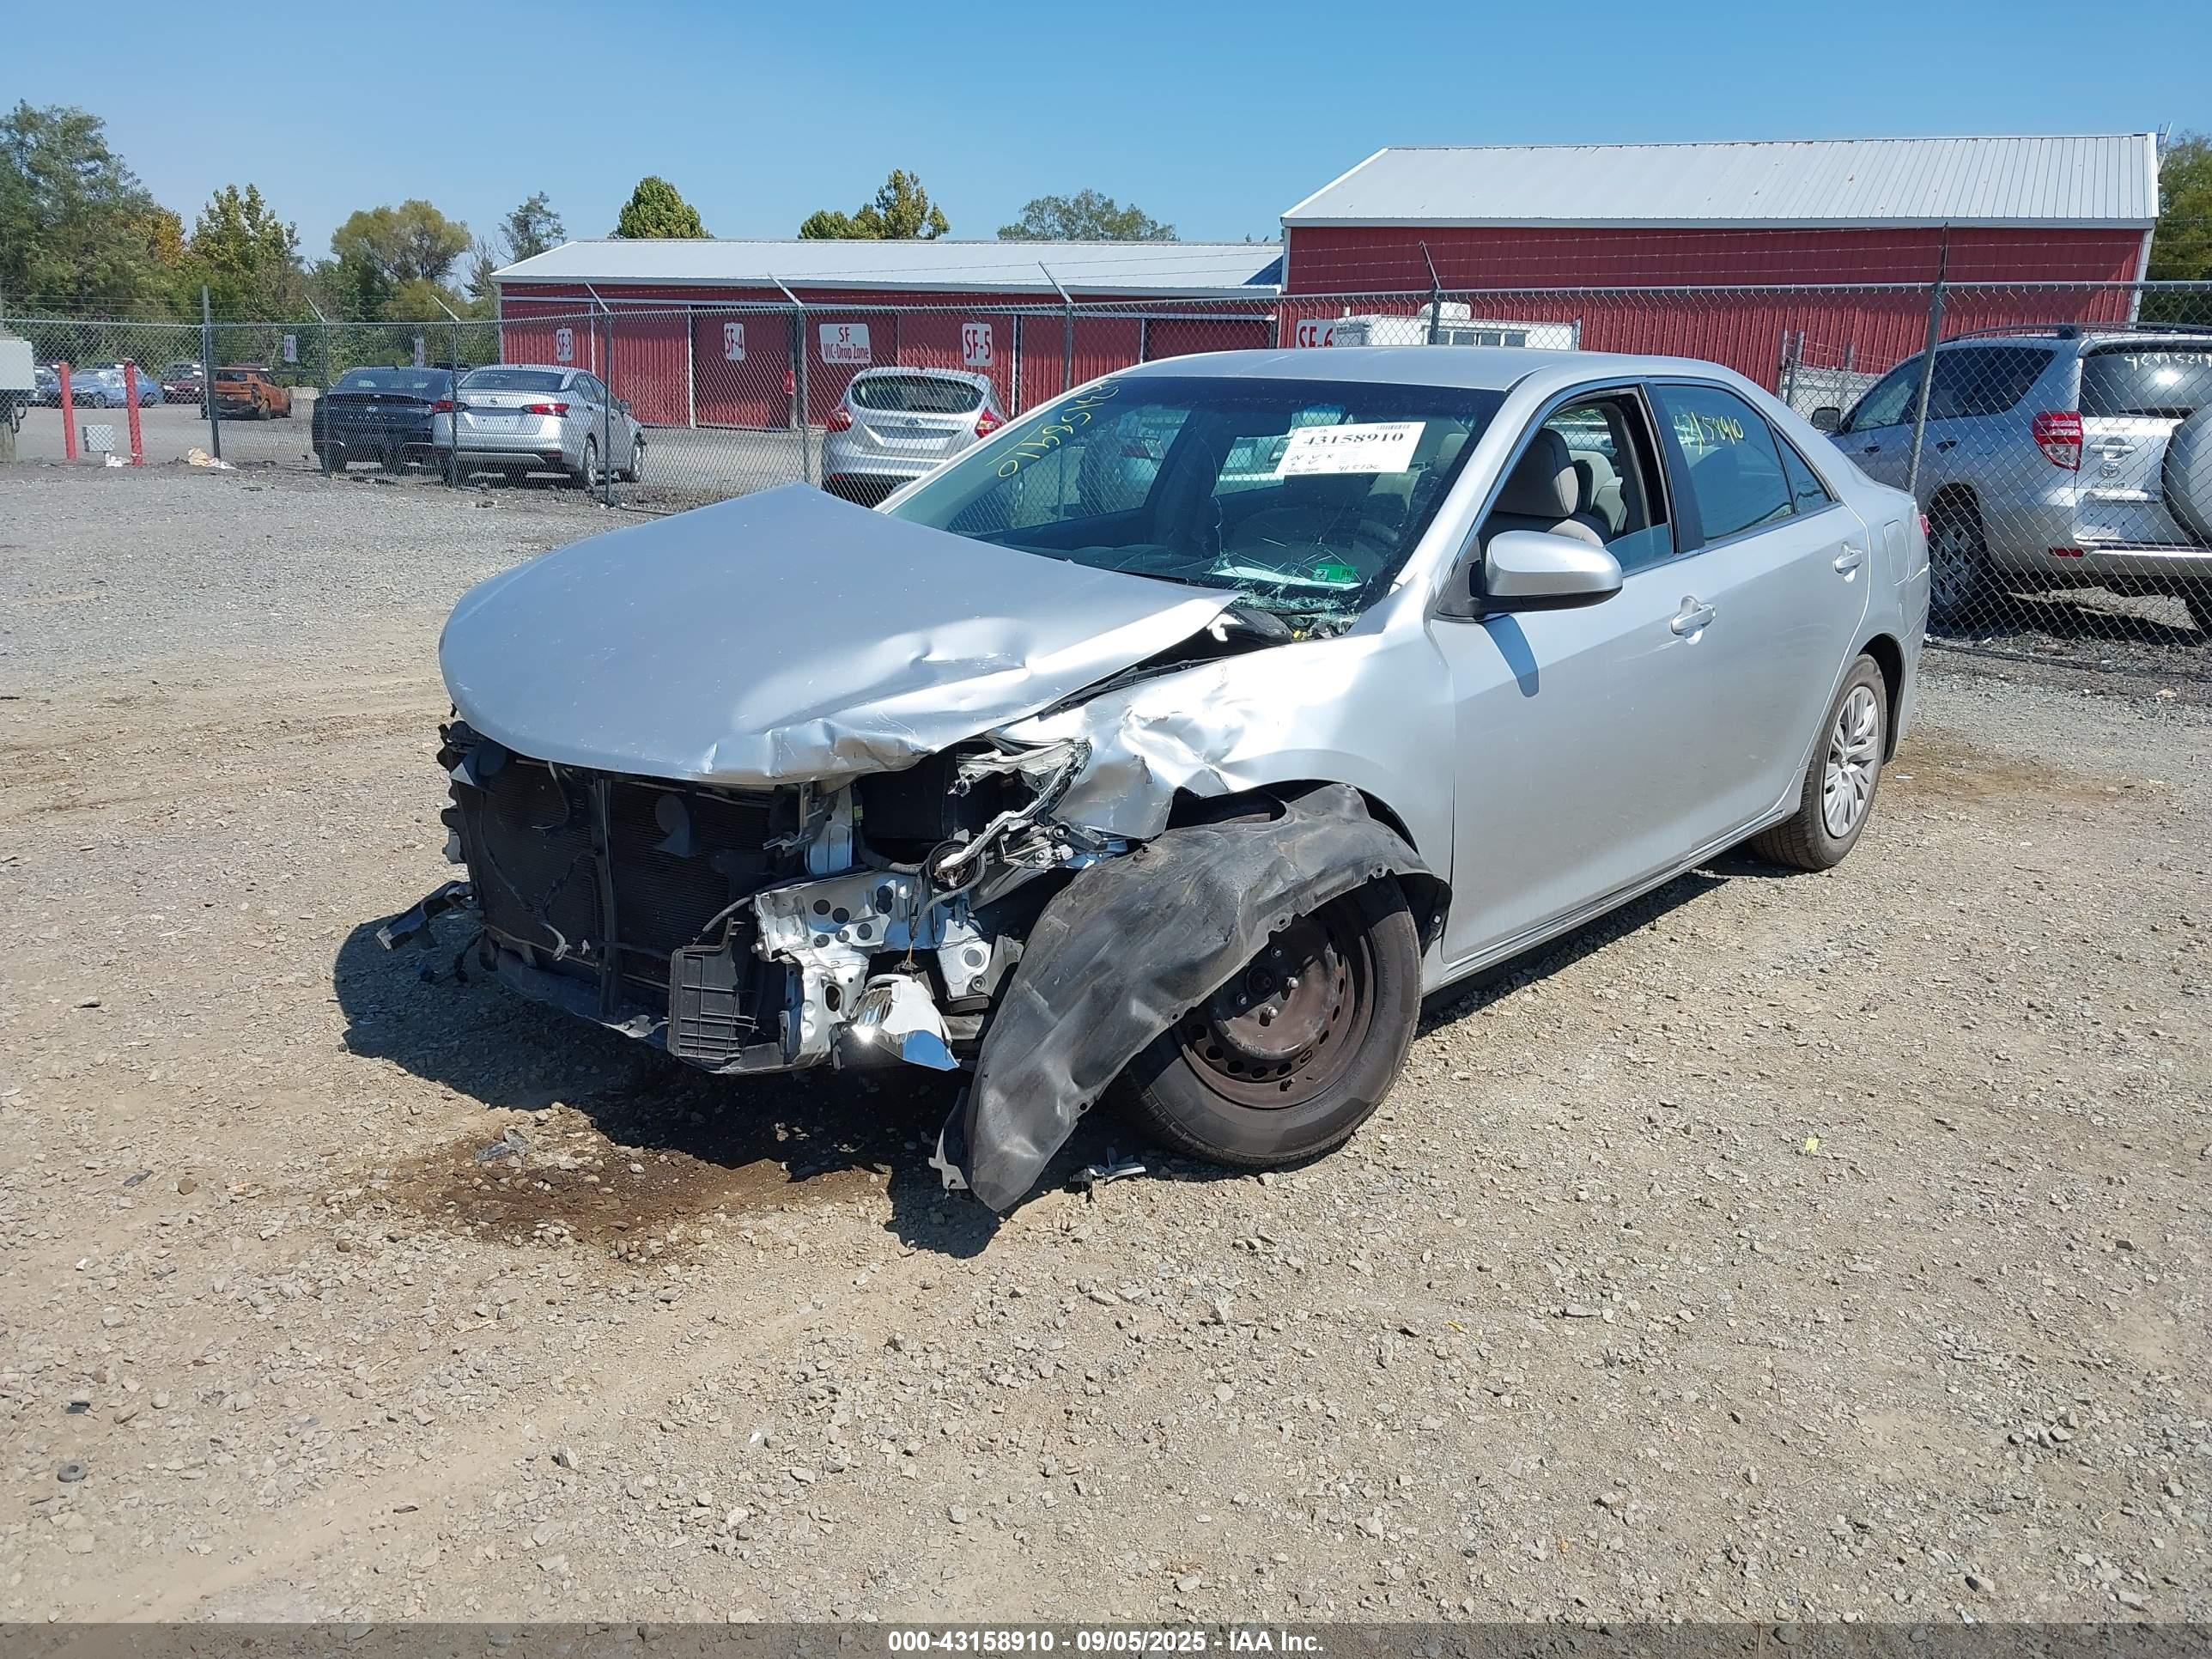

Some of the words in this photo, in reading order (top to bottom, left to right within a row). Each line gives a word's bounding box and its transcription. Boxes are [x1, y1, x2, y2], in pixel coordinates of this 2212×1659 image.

[558, 333, 572, 356] SF-3
[725, 328, 744, 355] SF-4
[838, 326, 850, 343] SF
[964, 328, 991, 360] SF-5
[823, 343, 853, 362] VIC-Drop
[853, 344, 870, 360] Zone
[1303, 432, 1405, 446] 43158910
